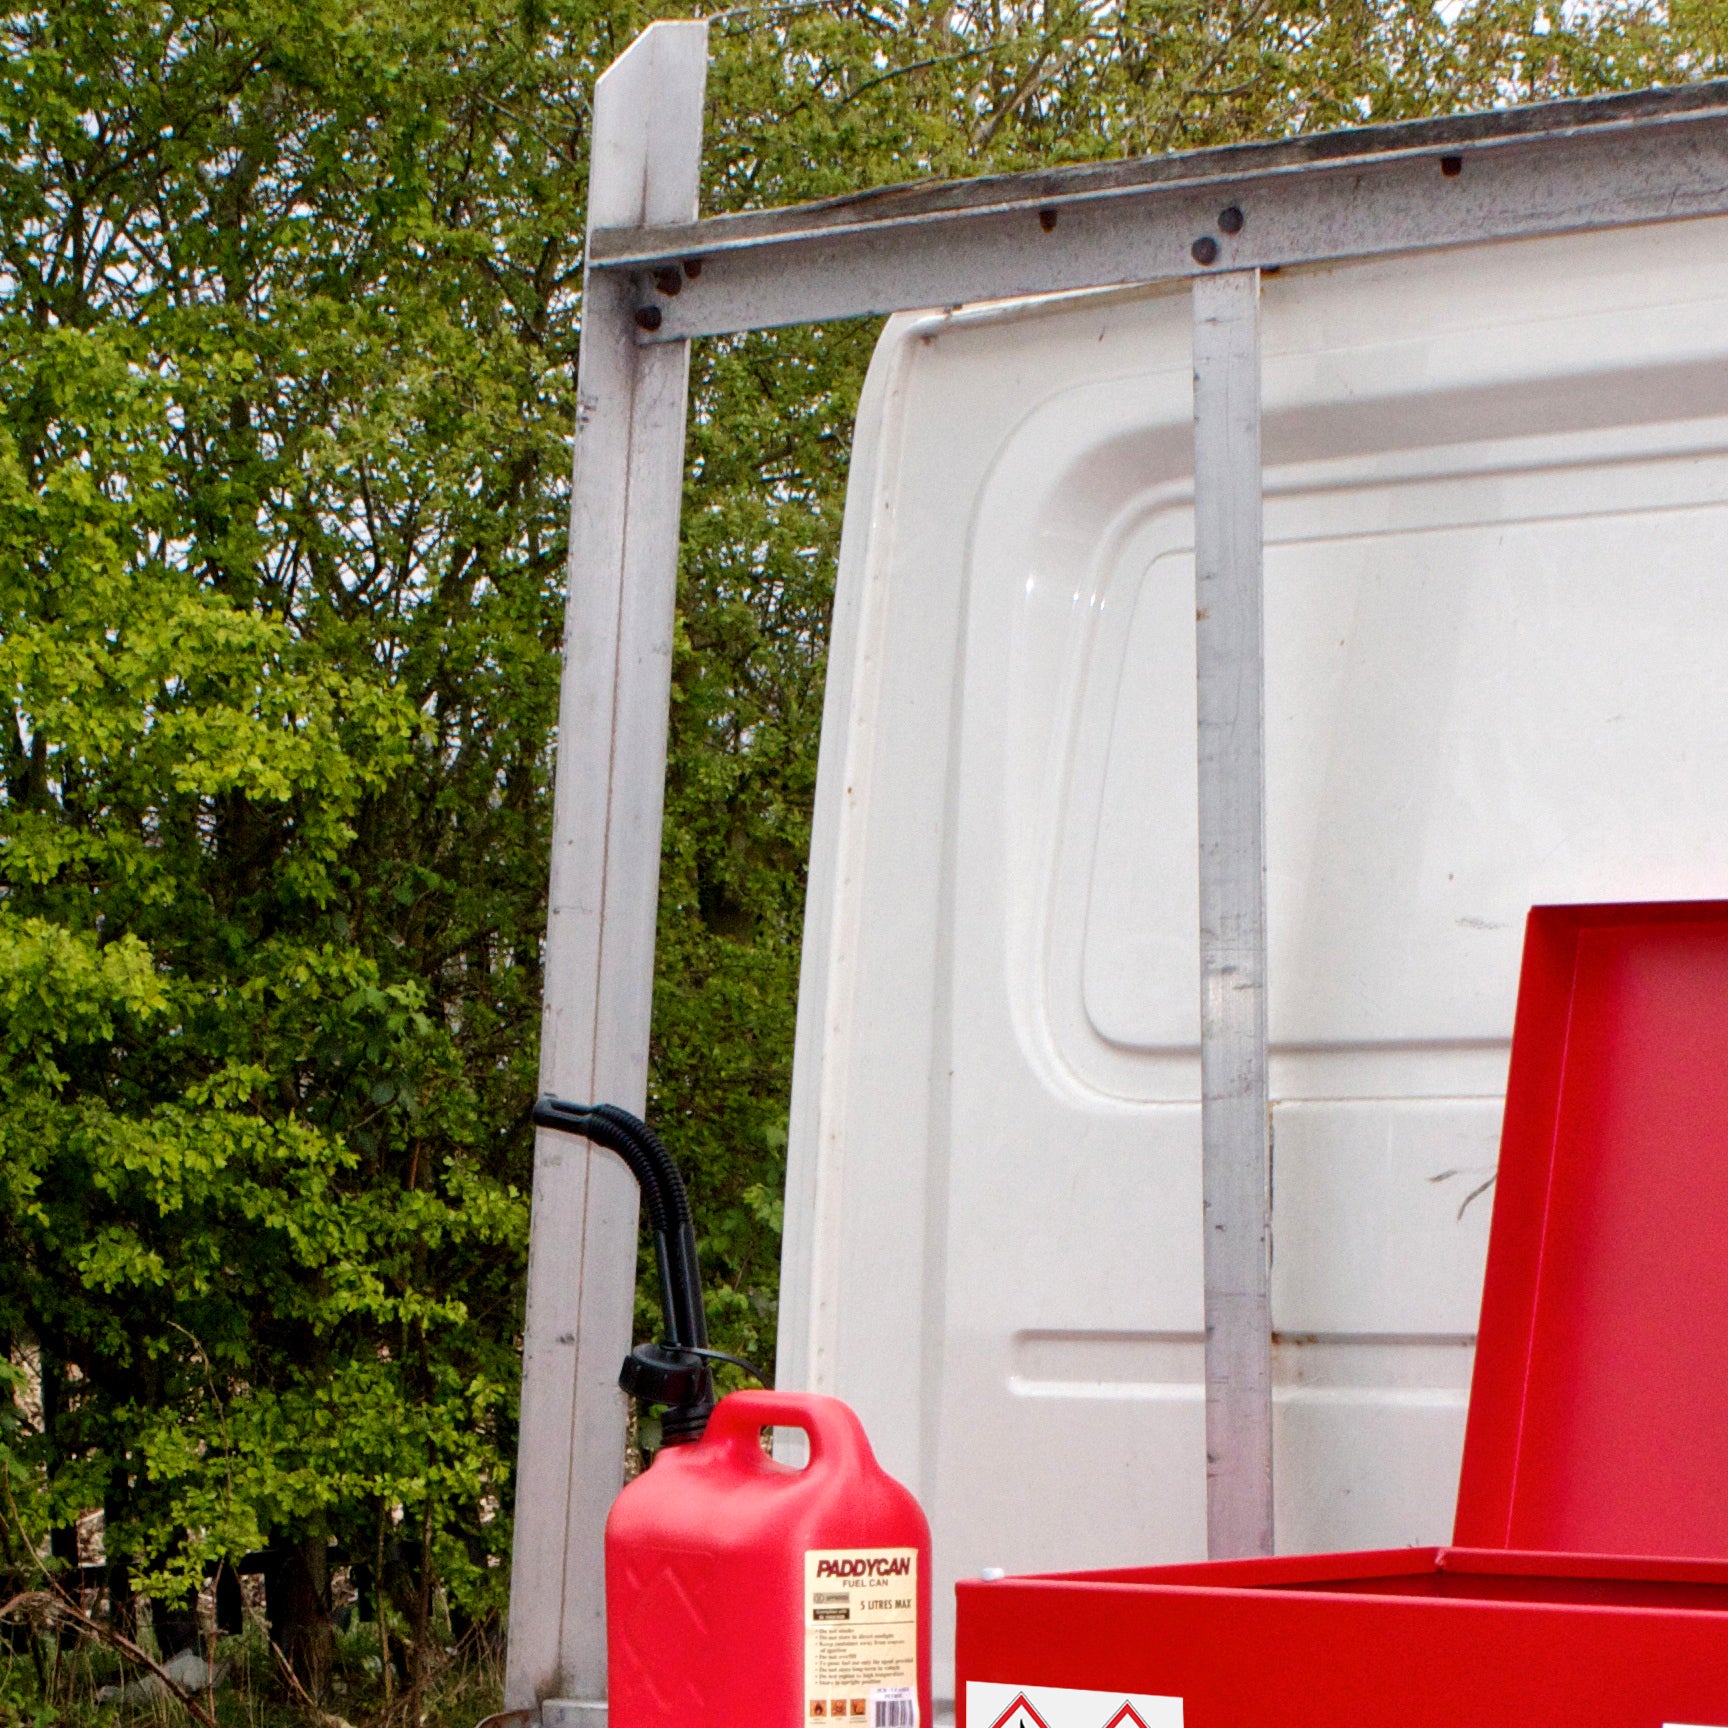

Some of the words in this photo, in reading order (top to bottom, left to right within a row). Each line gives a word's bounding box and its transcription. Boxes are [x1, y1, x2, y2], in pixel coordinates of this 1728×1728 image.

[816, 1557, 911, 1578] PADDYCAN
[842, 1580, 867, 1588] FUEL
[869, 1579, 889, 1587] CAN
[860, 1600, 866, 1611] 5
[868, 1599, 892, 1610] LITRES
[895, 1599, 912, 1609] MAX
